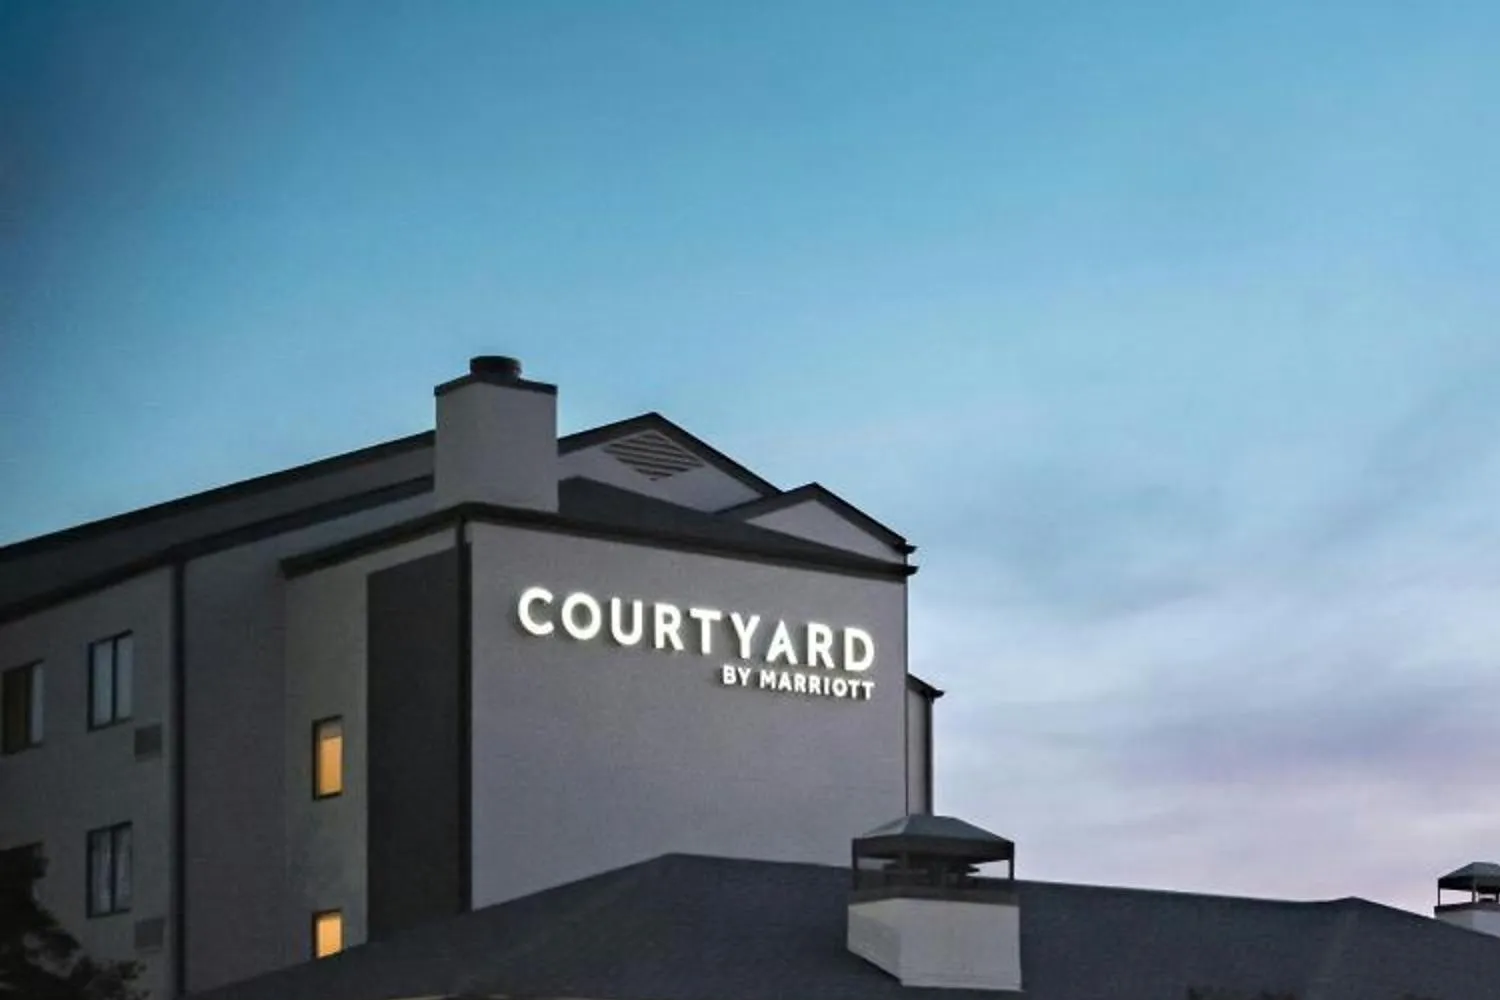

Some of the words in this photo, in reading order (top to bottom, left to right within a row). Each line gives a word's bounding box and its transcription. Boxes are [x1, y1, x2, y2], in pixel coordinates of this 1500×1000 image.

[518, 586, 875, 672] COURTYARD
[723, 664, 751, 687] BY
[759, 669, 875, 700] MARRIOTT
